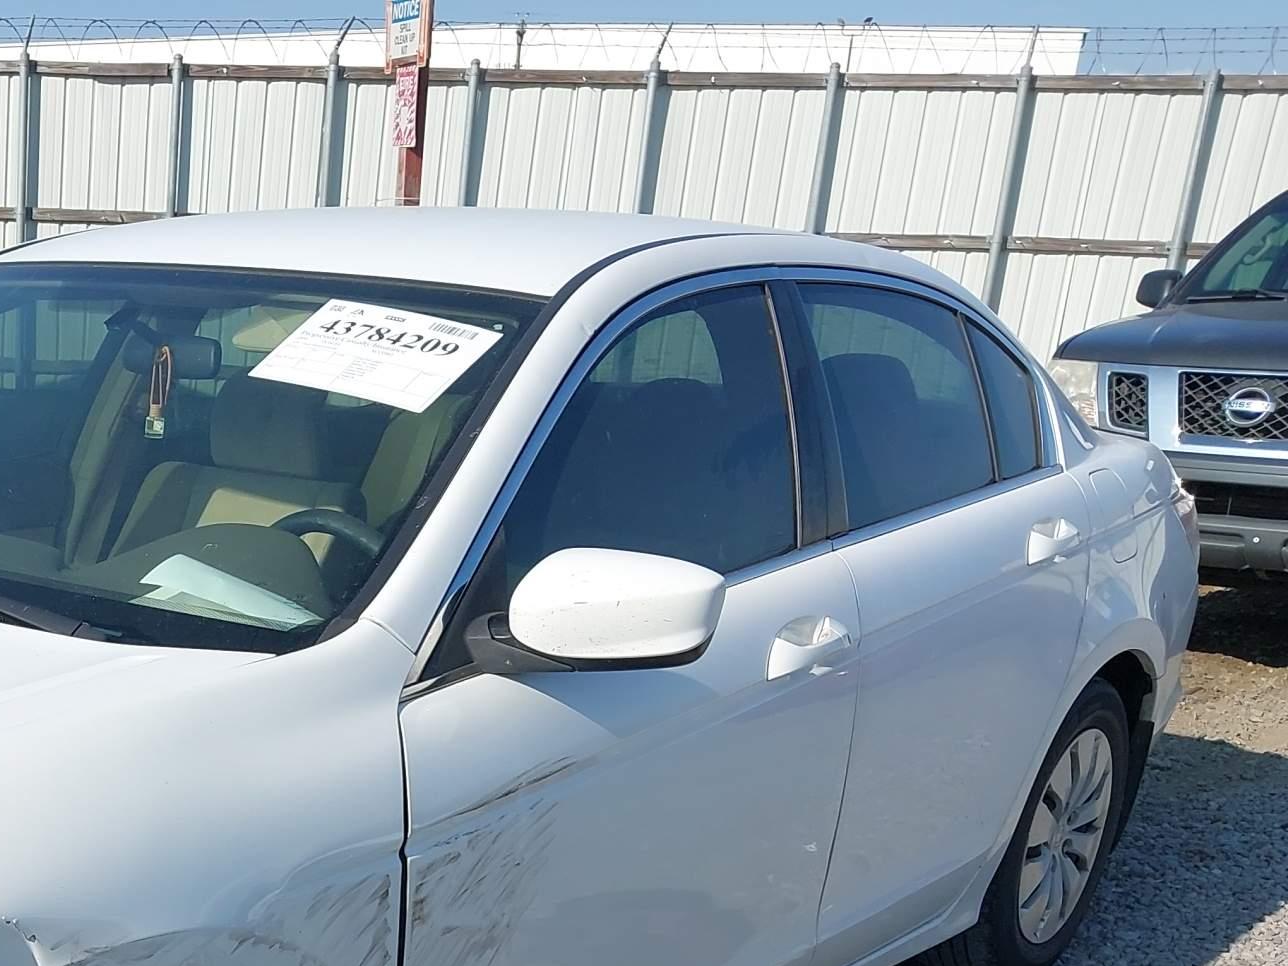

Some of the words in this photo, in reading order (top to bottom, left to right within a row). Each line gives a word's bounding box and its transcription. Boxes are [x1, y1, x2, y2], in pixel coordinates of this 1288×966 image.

[392, 0, 419, 20] NOTICE
[399, 23, 412, 33] SPILL
[394, 34, 409, 45] CLEAN
[409, 32, 416, 42] UP
[320, 320, 460, 356] 43784209
